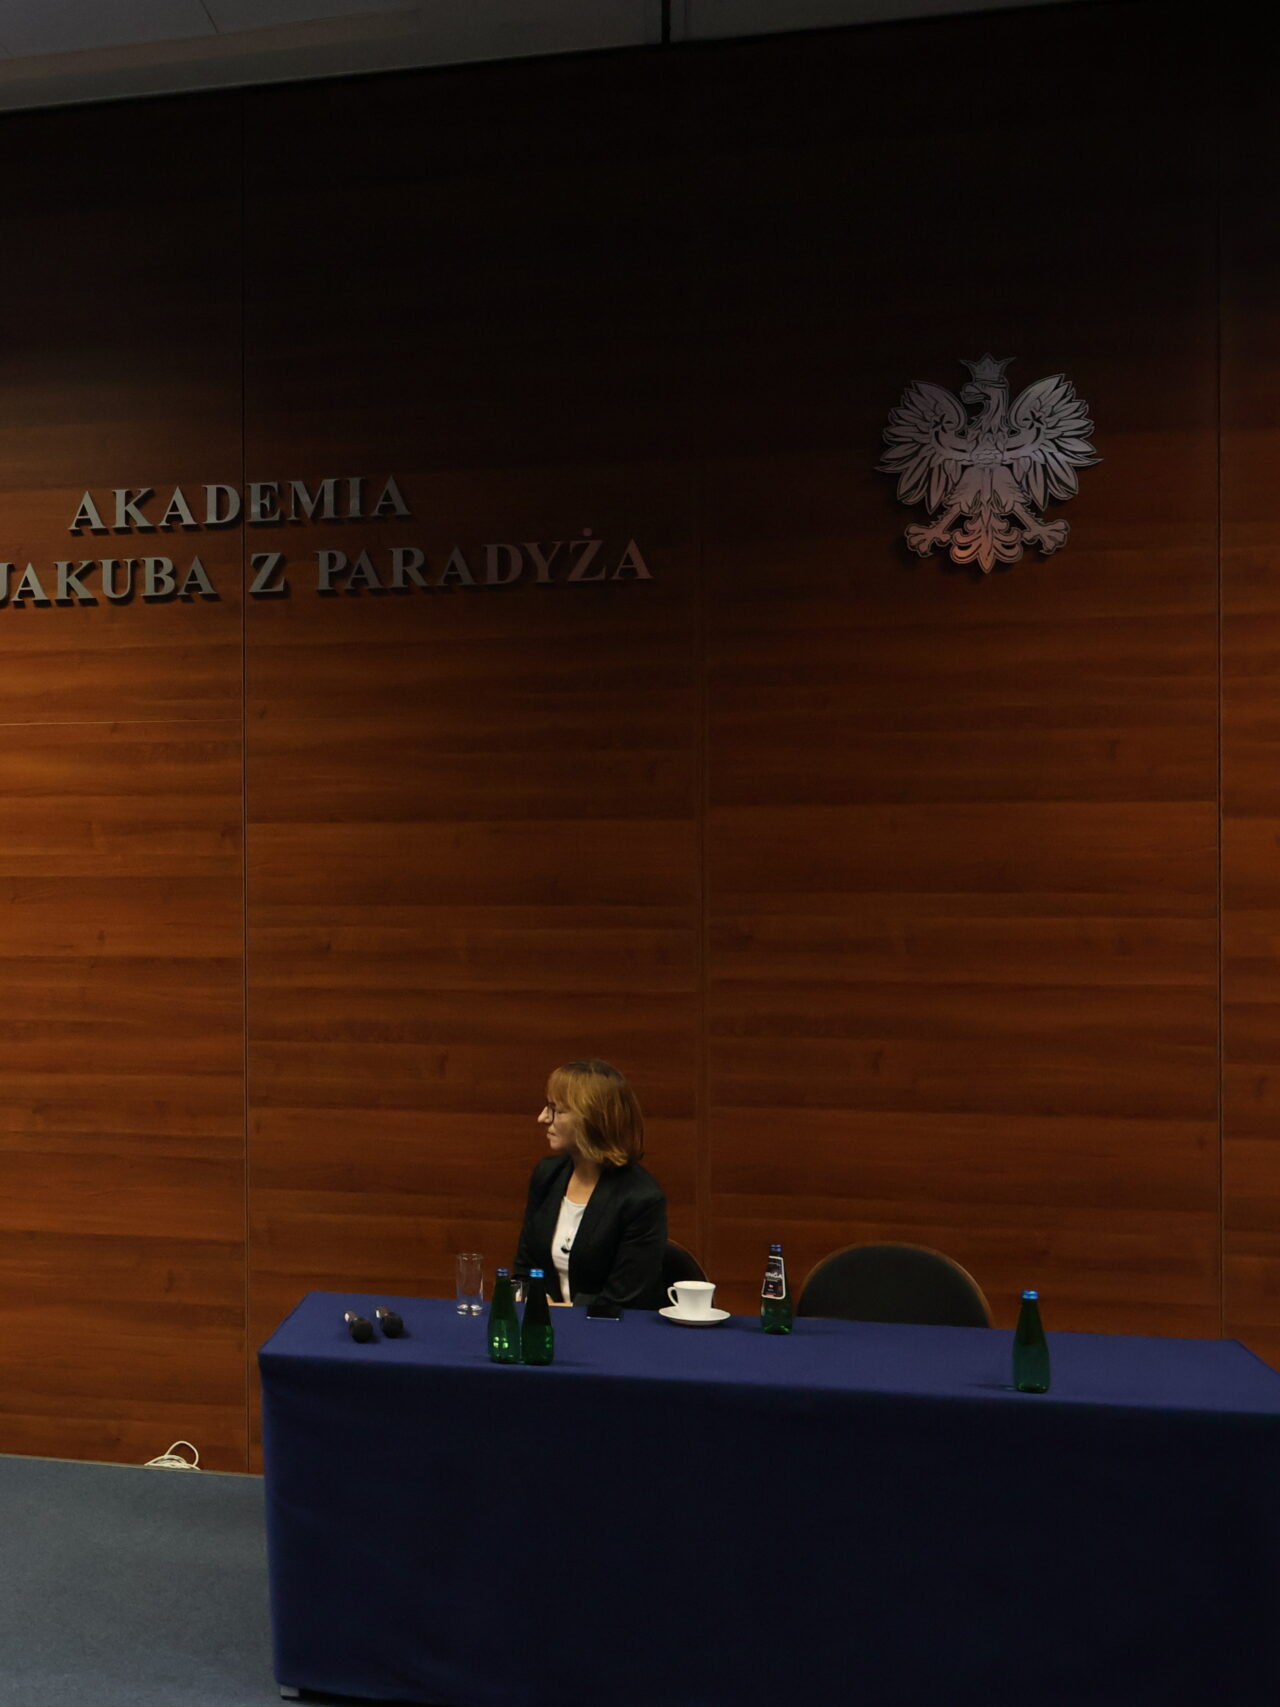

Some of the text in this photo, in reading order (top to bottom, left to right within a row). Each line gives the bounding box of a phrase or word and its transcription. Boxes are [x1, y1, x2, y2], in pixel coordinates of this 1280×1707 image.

[68, 475, 411, 531] AKADEMIA
[249, 551, 286, 595] Z
[318, 527, 654, 592] PARADYŻA
